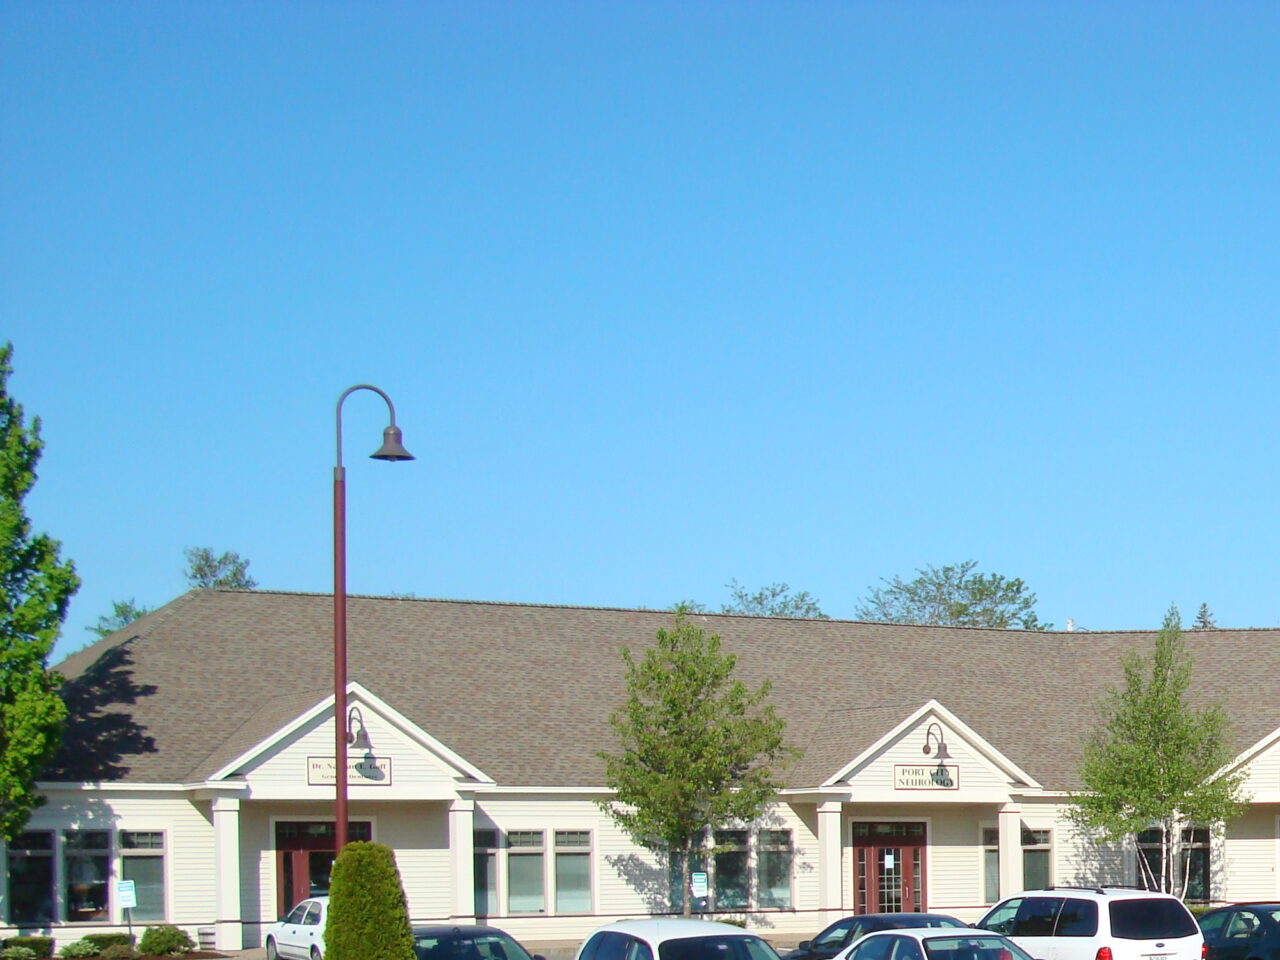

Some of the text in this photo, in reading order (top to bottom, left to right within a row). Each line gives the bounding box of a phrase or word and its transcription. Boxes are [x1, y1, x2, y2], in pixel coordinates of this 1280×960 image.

[901, 768, 951, 776] PORT CITY
[898, 778, 955, 787] NEUROLOGY
